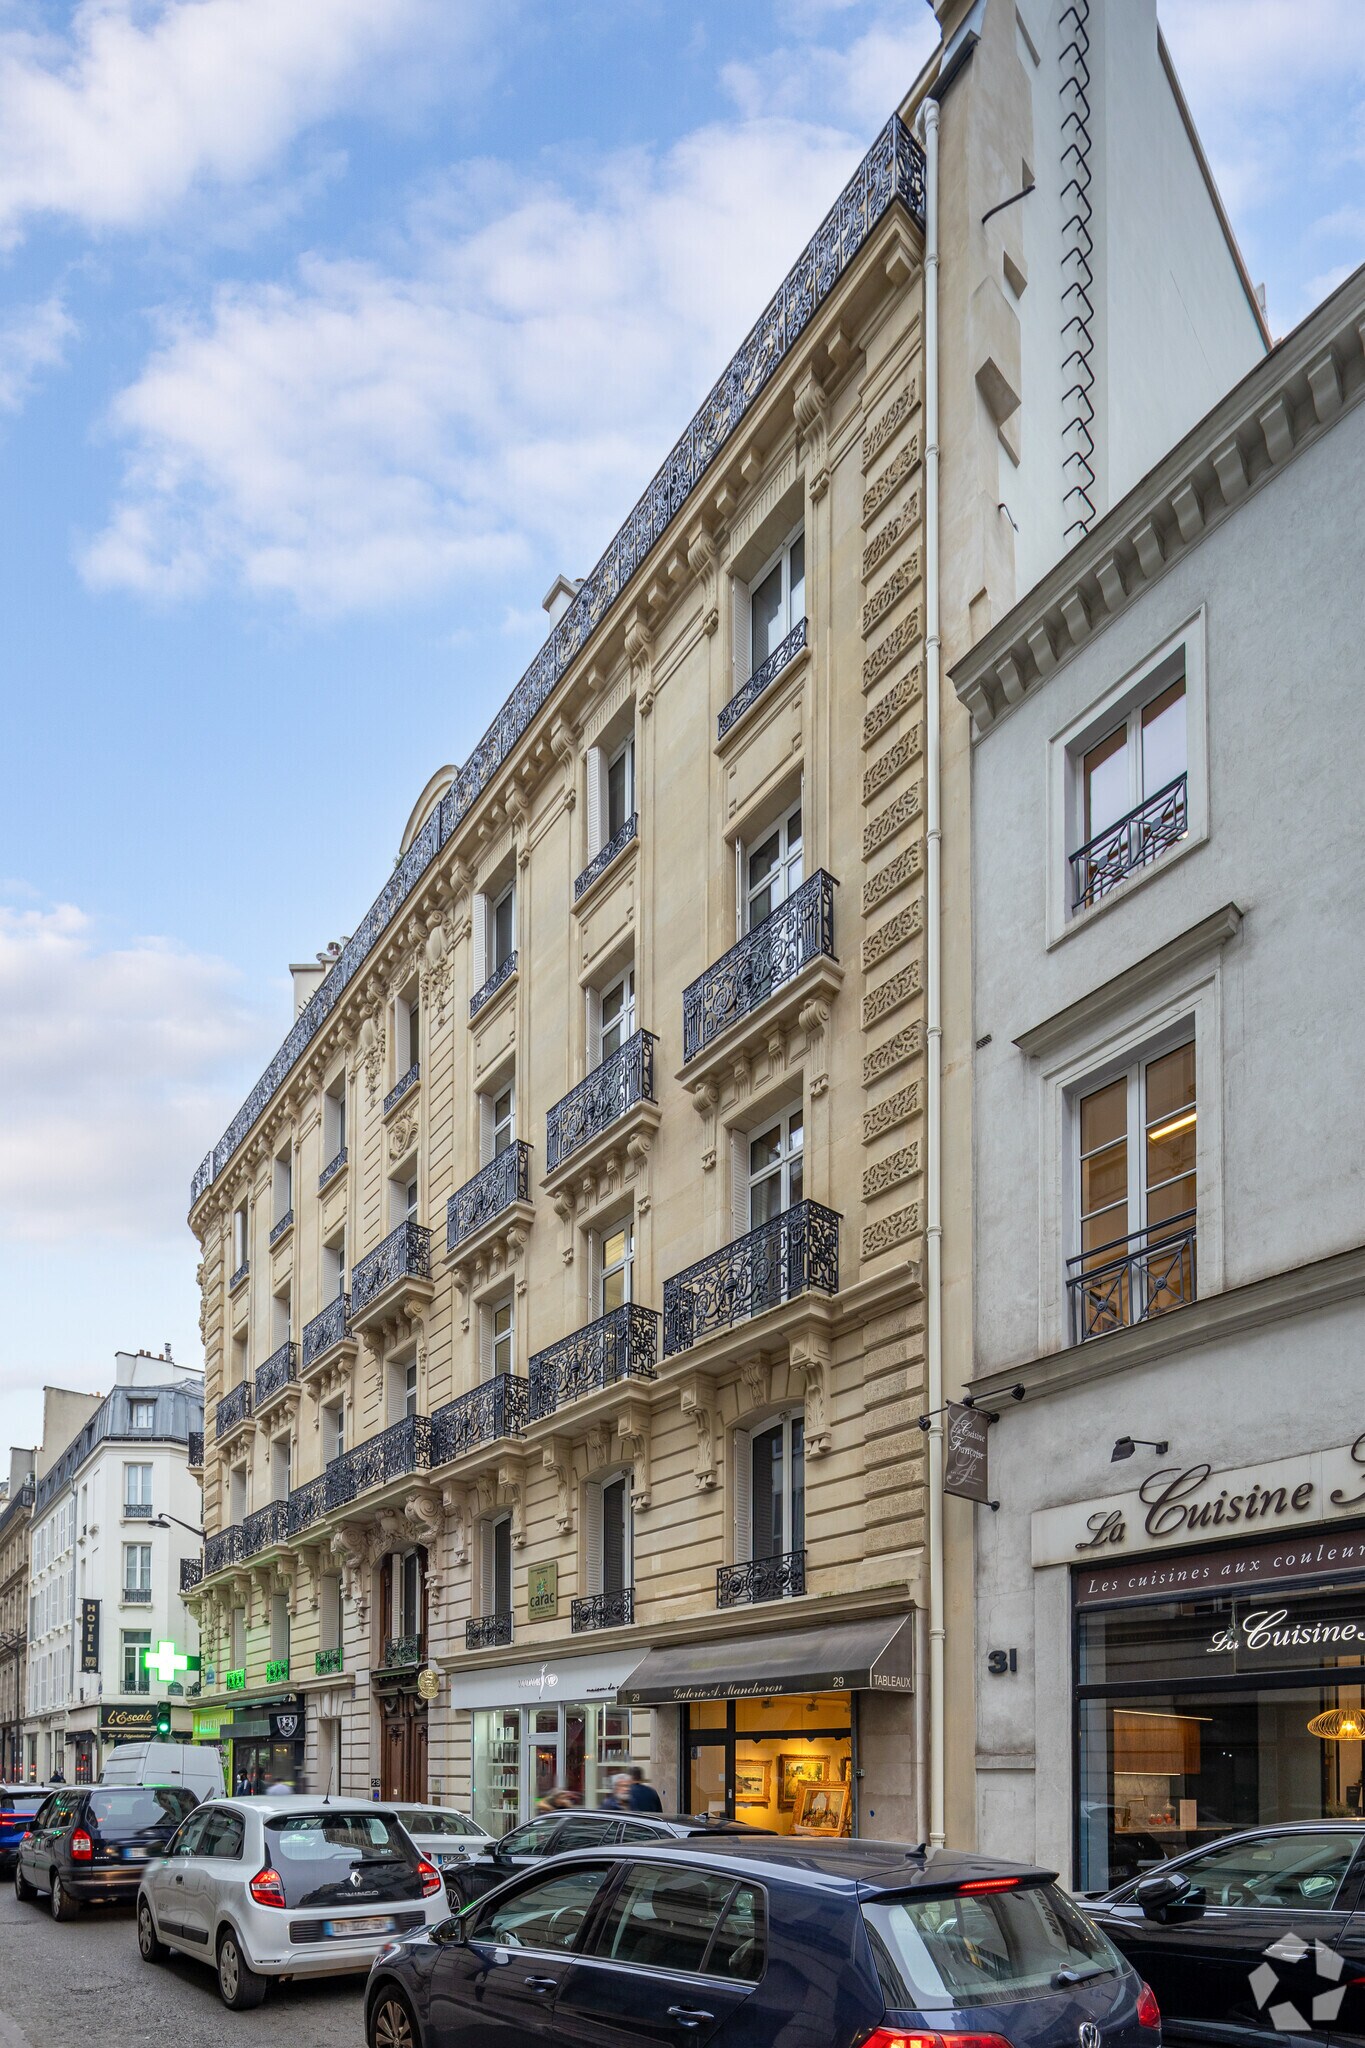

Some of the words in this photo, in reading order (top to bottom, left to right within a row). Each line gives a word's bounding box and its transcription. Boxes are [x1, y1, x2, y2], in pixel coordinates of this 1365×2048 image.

[960, 1419, 986, 1443] Cuisine
[1075, 1510, 1126, 1549] La
[1138, 1463, 1314, 1537] Cuisine
[1088, 1579, 1118, 1594] Les
[1128, 1567, 1210, 1589] cuisines
[1221, 1559, 1260, 1576] aux
[530, 1592, 555, 1608] carac
[86, 1604, 96, 1652] HOTEL
[1206, 1630, 1239, 1653] La
[1242, 1609, 1357, 1650] Cuisine
[987, 1648, 1018, 1674] 31
[673, 1688, 707, 1699] Galerie
[722, 1682, 783, 1696] Mancheron
[832, 1676, 845, 1688] 29
[873, 1674, 911, 1688] TABLEAUX
[631, 1693, 640, 1702] 29
[107, 1710, 154, 1725] l'Escale
